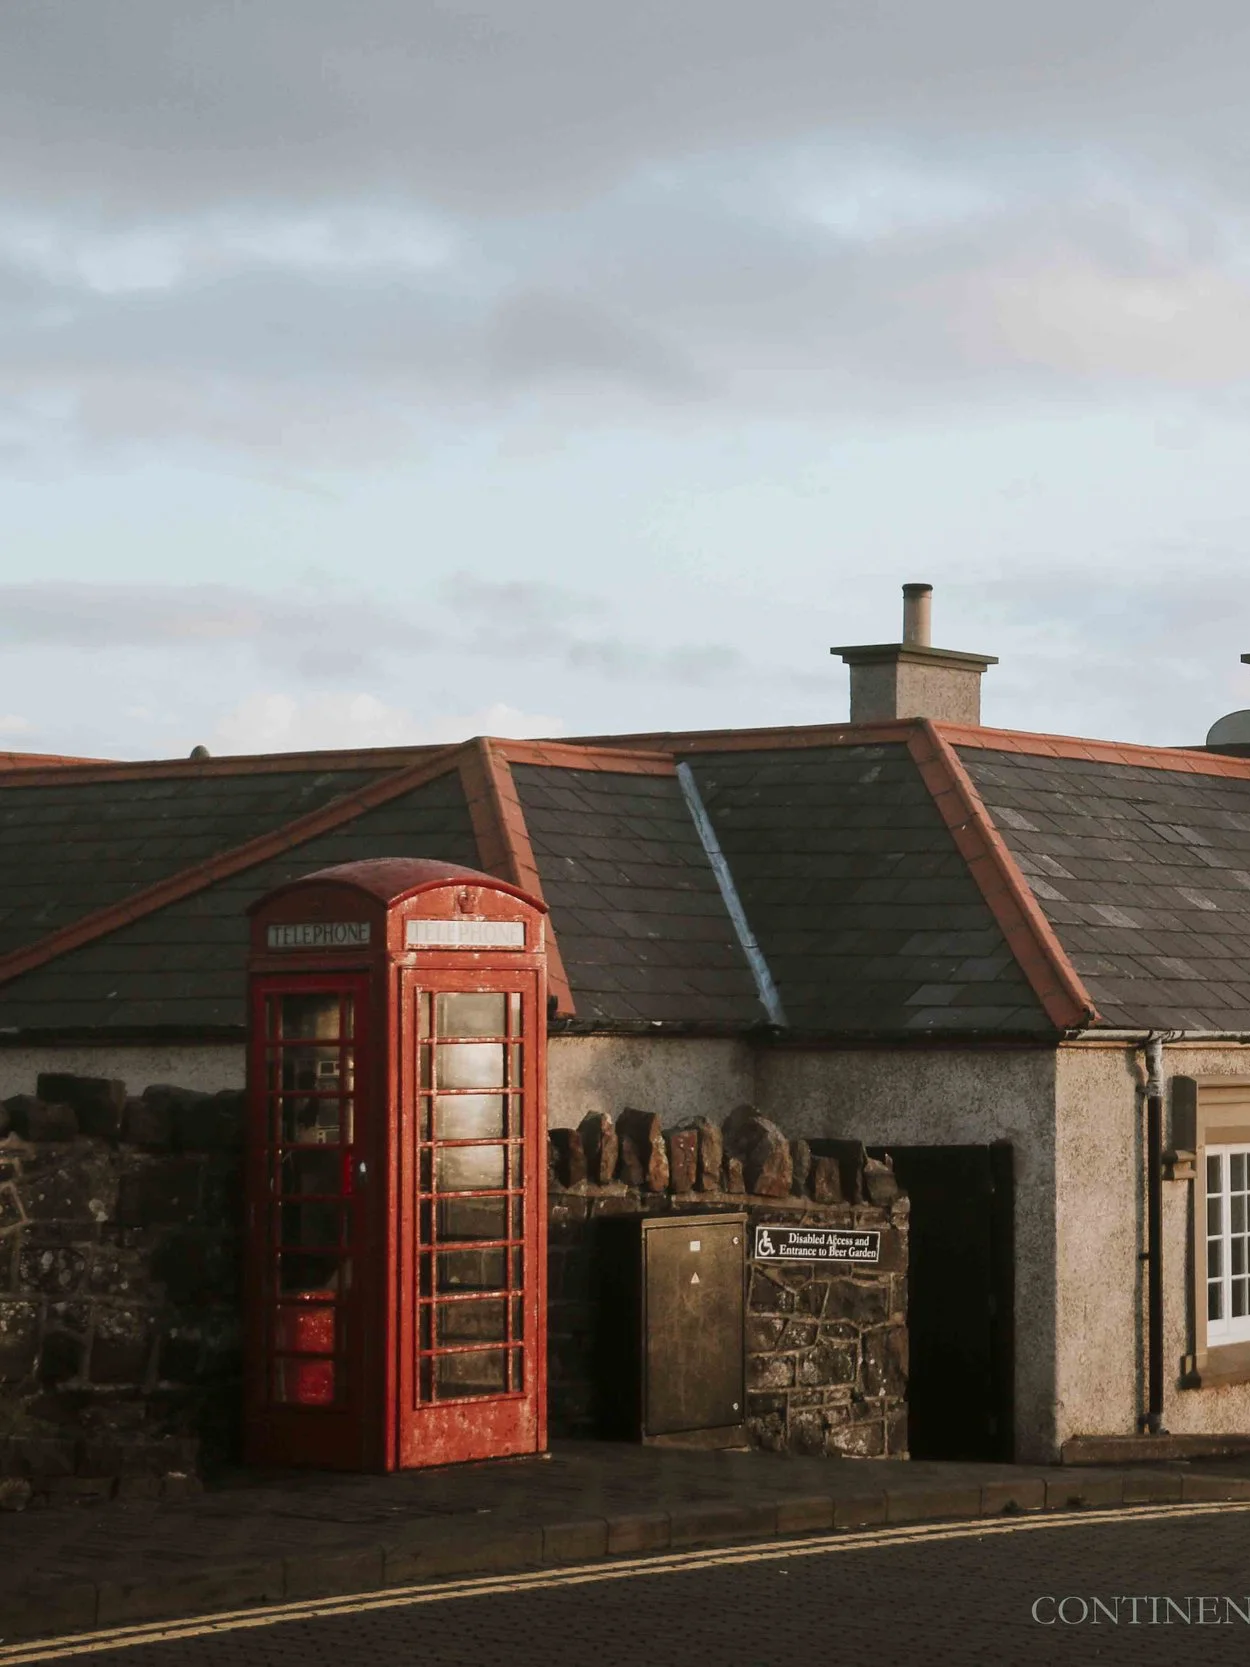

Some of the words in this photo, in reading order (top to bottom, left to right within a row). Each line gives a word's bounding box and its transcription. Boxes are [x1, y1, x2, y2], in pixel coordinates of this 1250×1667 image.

[272, 924, 369, 945] TELEPHONE
[410, 922, 522, 944] TELEPHONE
[788, 1232, 825, 1245] Disabled
[826, 1234, 853, 1246] Access
[854, 1236, 870, 1247] and
[779, 1244, 817, 1256] Entrance
[818, 1247, 827, 1257] to
[828, 1246, 847, 1258] Beer
[848, 1246, 877, 1258] Garden
